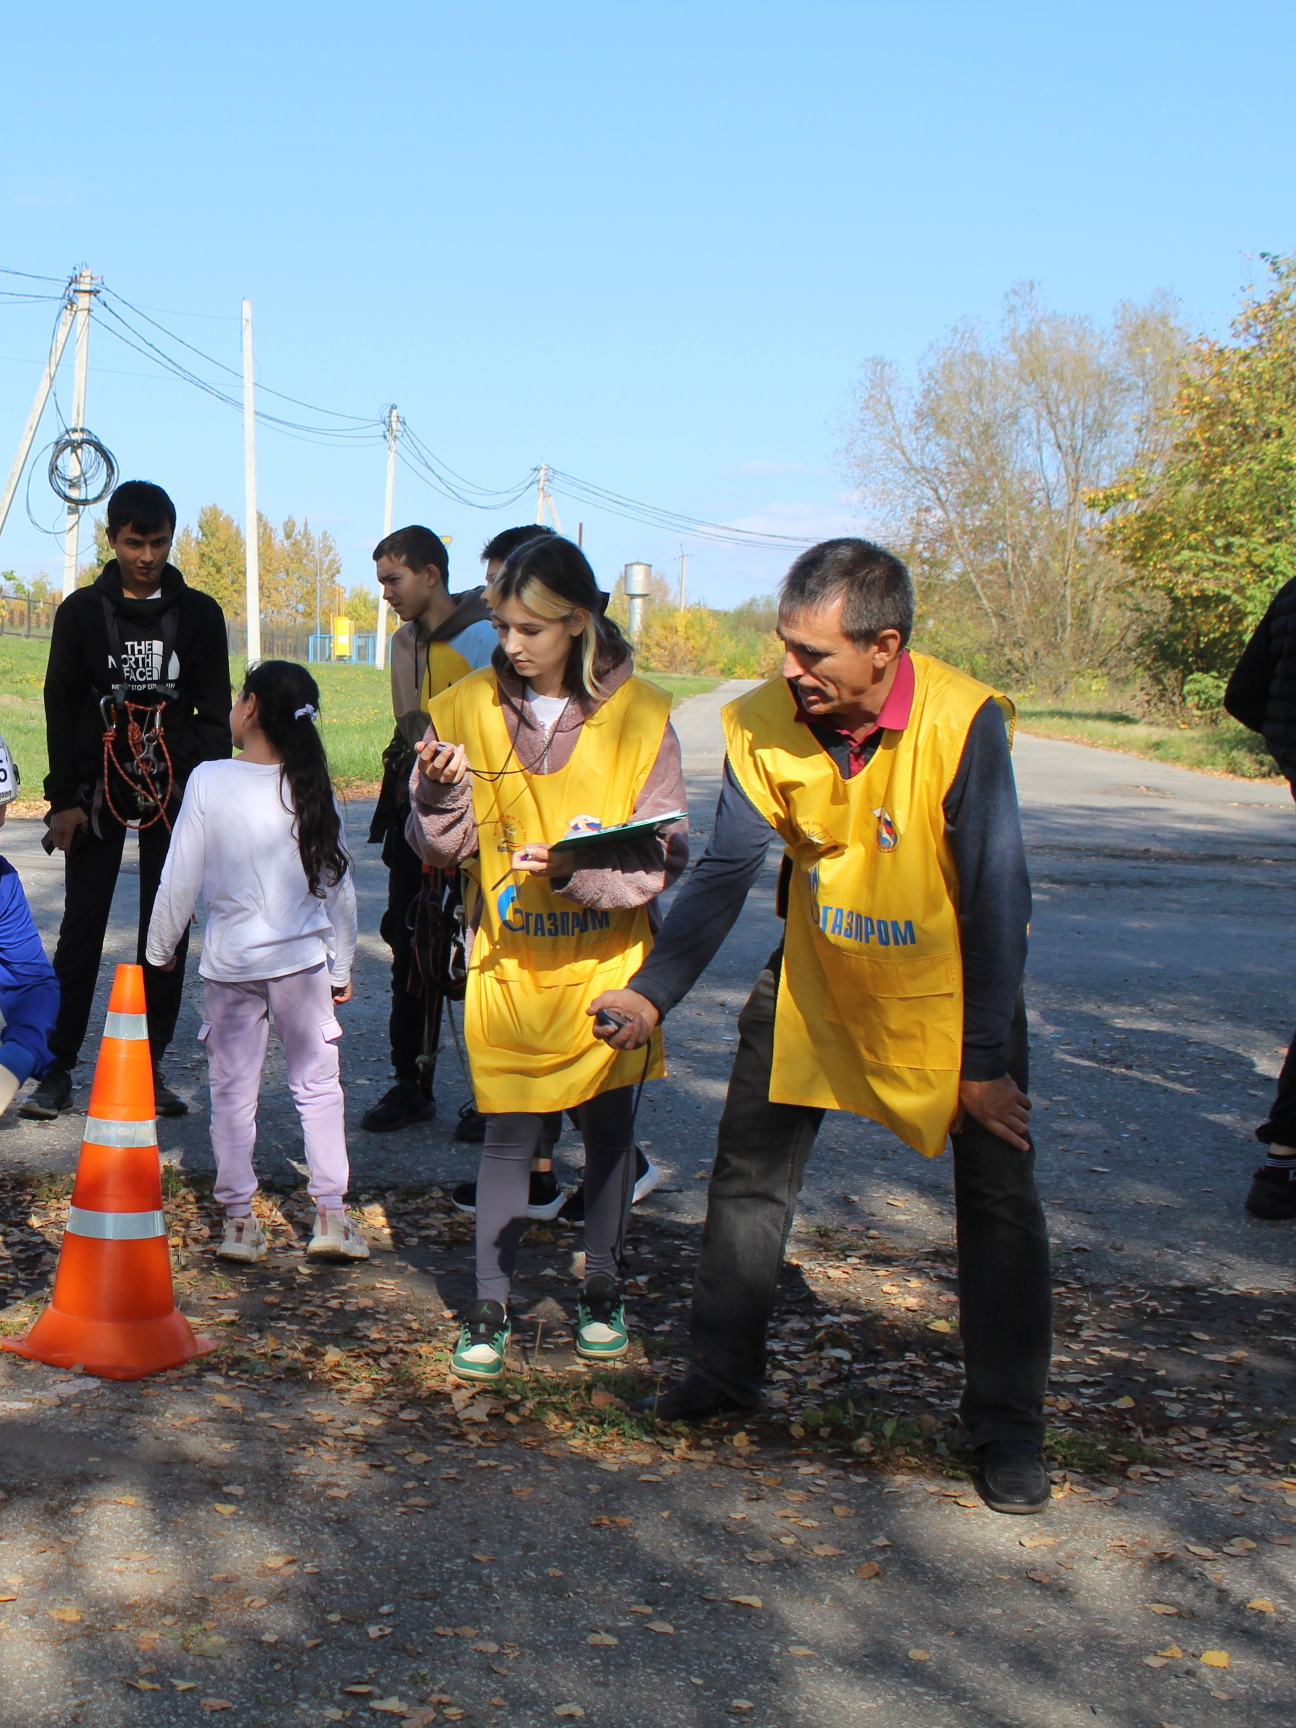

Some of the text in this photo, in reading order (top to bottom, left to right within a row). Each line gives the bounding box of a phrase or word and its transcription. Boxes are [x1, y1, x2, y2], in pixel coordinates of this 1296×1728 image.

[124, 640, 153, 655] THE
[123, 667, 153, 682] FACE
[524, 907, 610, 937] ГАЗПРОМ
[819, 905, 917, 946] ГАЗПРОМ
